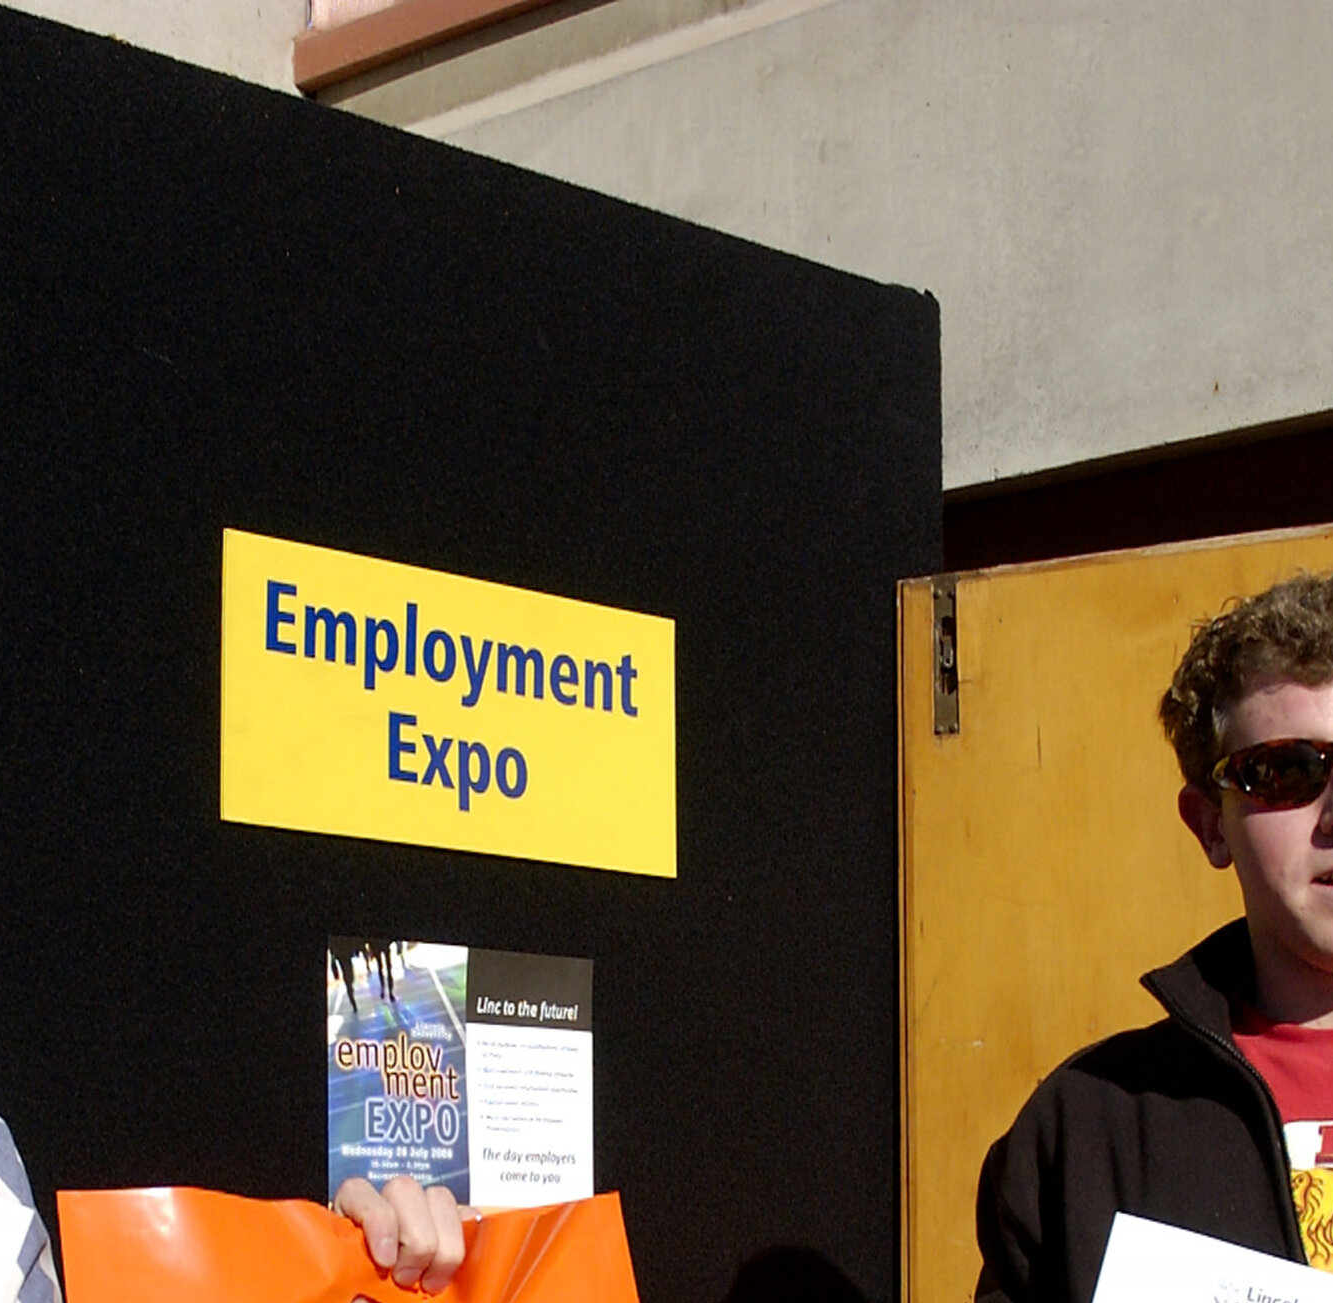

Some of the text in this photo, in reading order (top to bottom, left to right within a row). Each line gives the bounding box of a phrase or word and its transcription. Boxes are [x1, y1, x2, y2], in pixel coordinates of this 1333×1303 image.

[265, 579, 638, 718] Employment
[387, 711, 528, 812] Expo
[476, 996, 501, 1016] Linc
[503, 1000, 516, 1016] to
[517, 1000, 538, 1017] the
[385, 1066, 460, 1100] ment
[365, 1098, 460, 1145] EXPO
[340, 1144, 394, 1159] Wednesday
[482, 1147, 577, 1166] The day employers
[499, 1171, 561, 1185] come to you
